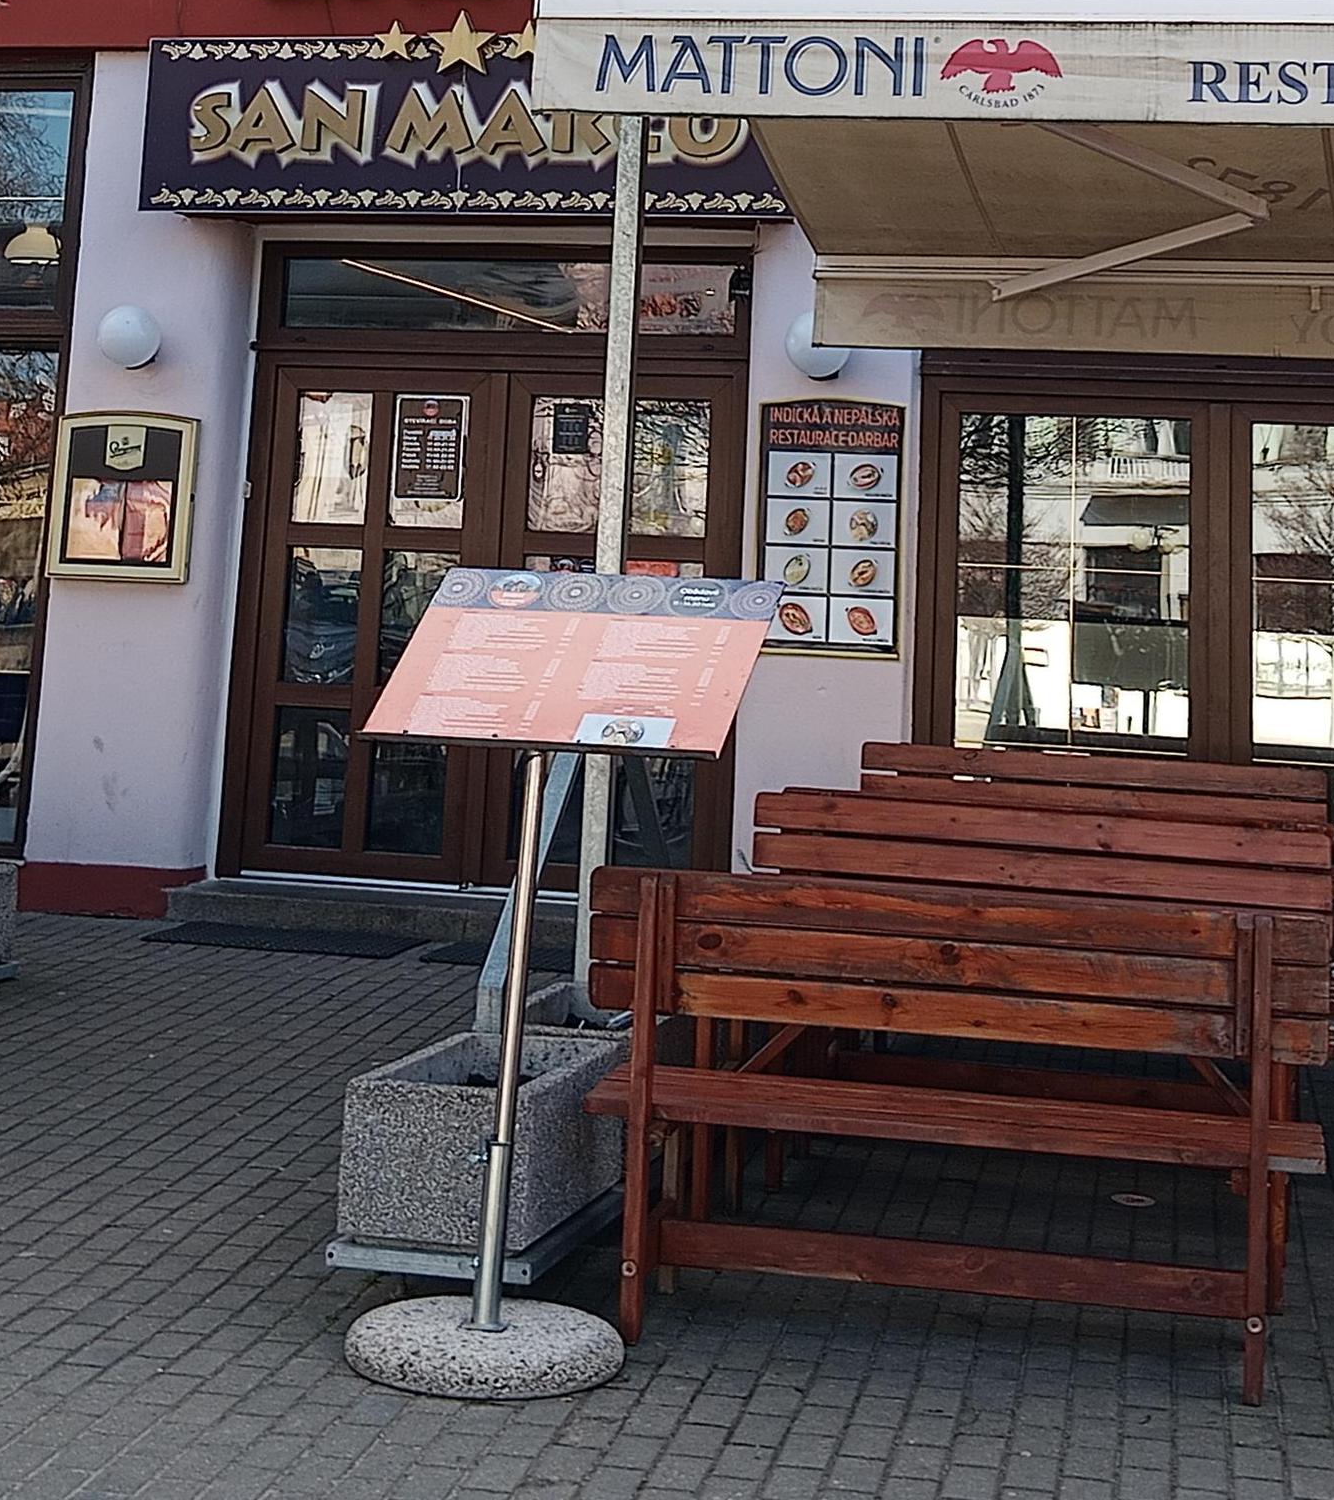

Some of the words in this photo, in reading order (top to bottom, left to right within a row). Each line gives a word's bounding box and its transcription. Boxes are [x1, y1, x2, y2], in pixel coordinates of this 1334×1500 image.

[595, 34, 925, 96] MATTONI
[959, 84, 1019, 109] CARLSBAD
[190, 82, 372, 161] SAN
[386, 82, 749, 161] MARO
[770, 404, 820, 424] INDICKÁ
[836, 405, 900, 426] NEPÁLSKÁ
